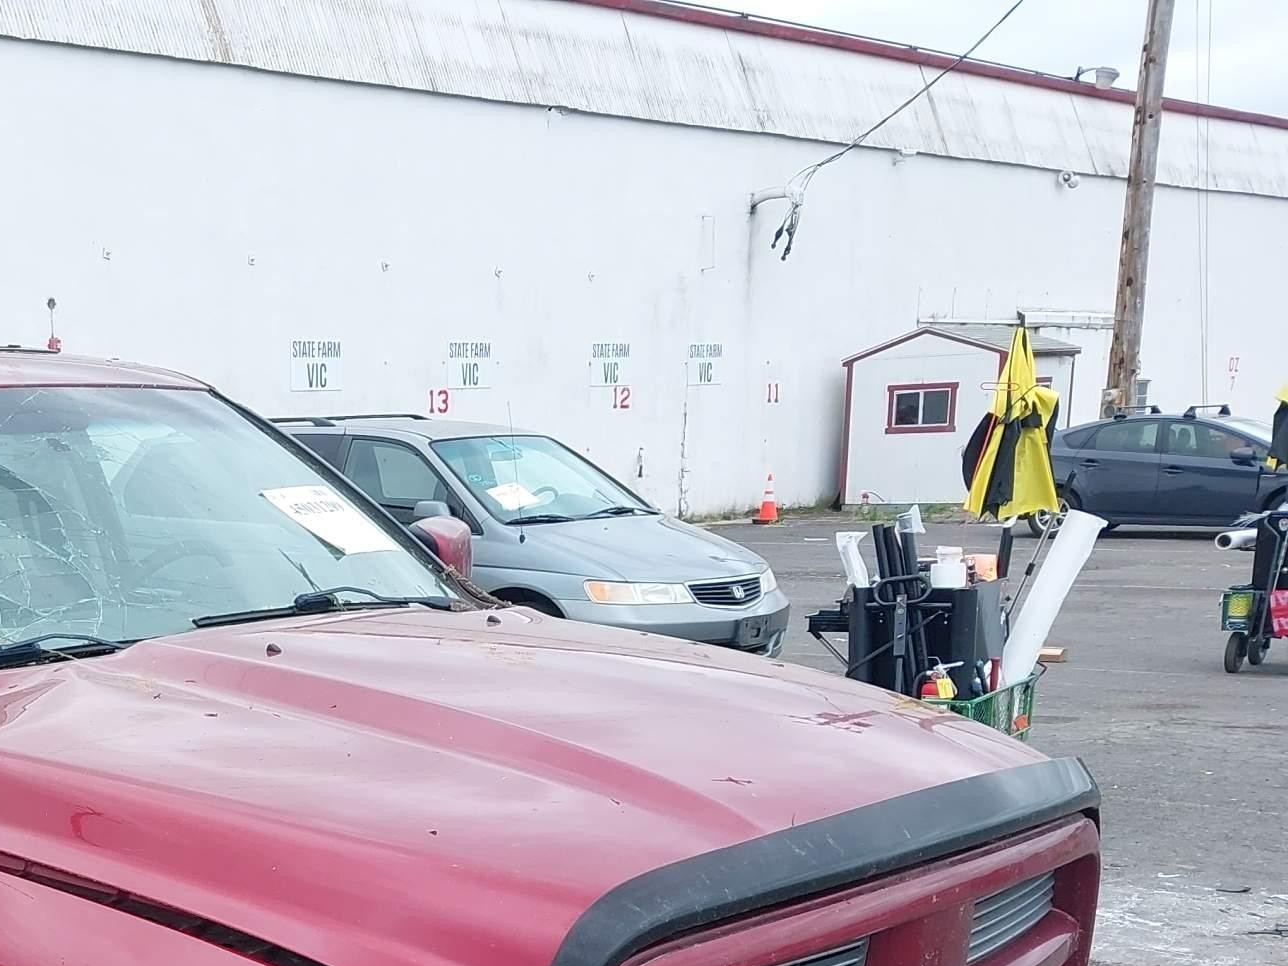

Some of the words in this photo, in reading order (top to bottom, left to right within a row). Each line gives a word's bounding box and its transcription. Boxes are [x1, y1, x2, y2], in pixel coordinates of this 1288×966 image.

[292, 341, 315, 358] STATE
[317, 341, 341, 358] FARM
[449, 342, 469, 359] STATE
[470, 342, 491, 359] FARM
[592, 343, 611, 359] STATE
[612, 343, 630, 359] FARM
[689, 344, 705, 359] STATE
[706, 344, 723, 359] FARM
[307, 363, 327, 388] VIC
[461, 363, 479, 386] VIC
[603, 362, 619, 384] VIC
[699, 362, 713, 383] VIC
[429, 389, 449, 413] 13
[613, 386, 630, 409] 12
[767, 383, 779, 403] 11
